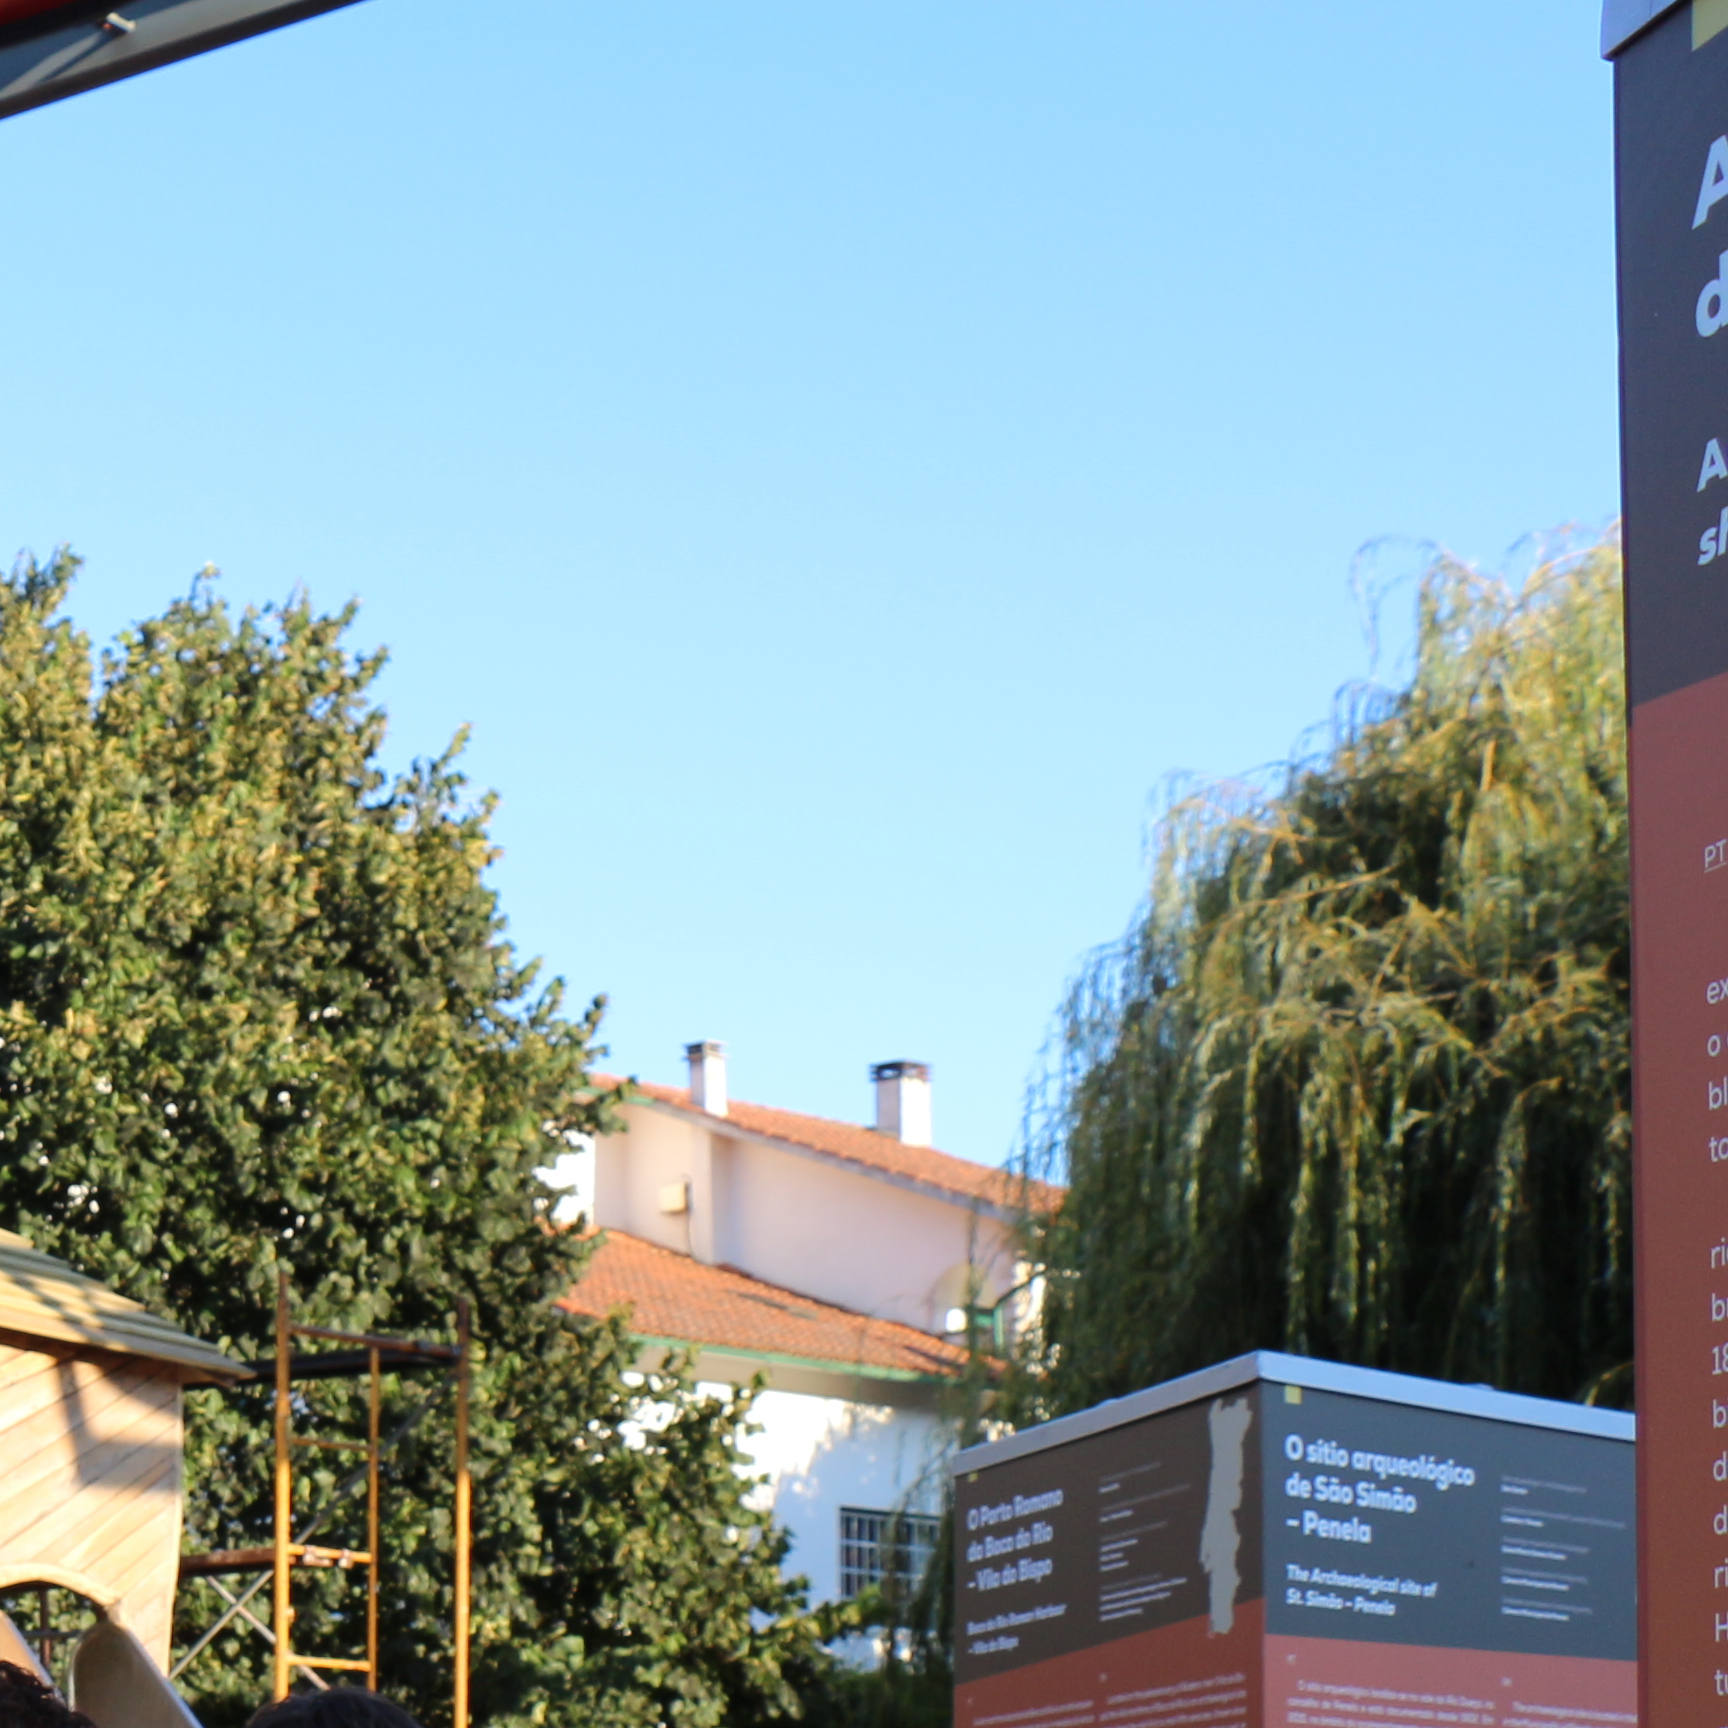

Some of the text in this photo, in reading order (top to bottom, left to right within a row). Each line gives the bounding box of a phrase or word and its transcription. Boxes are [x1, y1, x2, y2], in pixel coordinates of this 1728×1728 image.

[1704, 838, 1727, 868] PT
[1284, 1434, 1476, 1491] O sítio arqueológico
[967, 1488, 1064, 1530] O Porto Romano
[1285, 1472, 1418, 1514] de São Simão
[1032, 1522, 1054, 1545] Rio
[1303, 1510, 1373, 1544] Penela
[1019, 1556, 1053, 1583] Bispo
[1285, 1564, 1310, 1581] The
